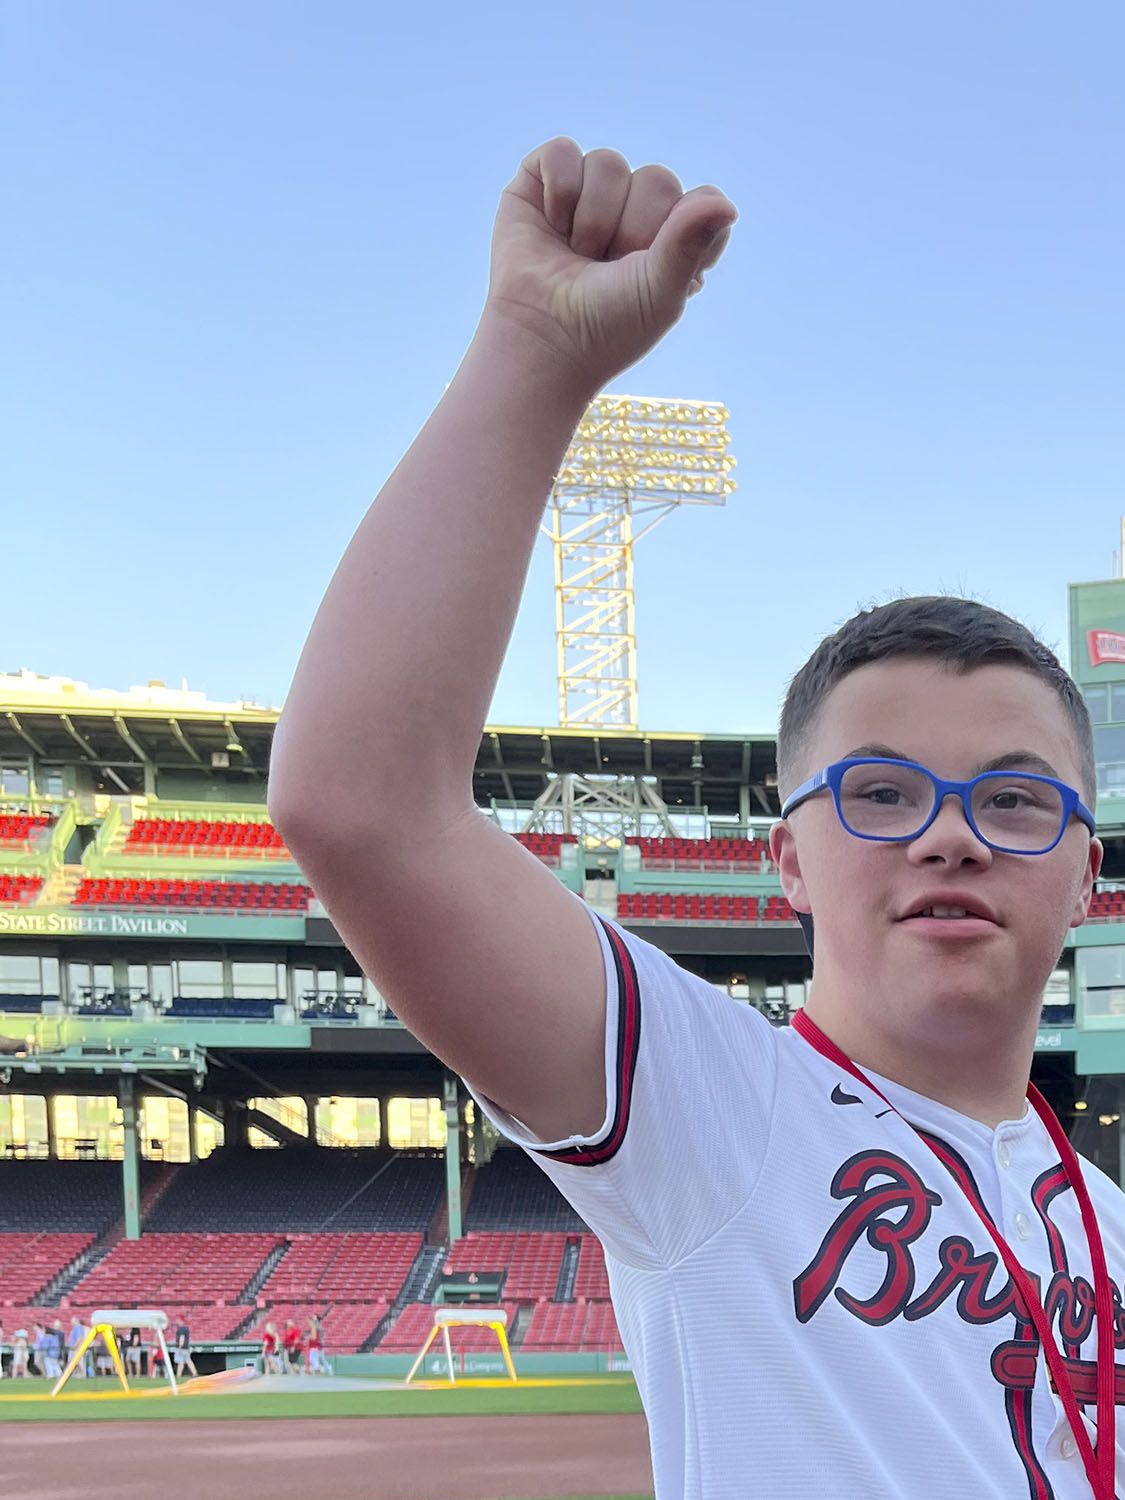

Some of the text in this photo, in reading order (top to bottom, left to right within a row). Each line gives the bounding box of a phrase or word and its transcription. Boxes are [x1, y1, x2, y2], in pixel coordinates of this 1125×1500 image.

[0, 913, 188, 934] STATE STREET PAVILION
